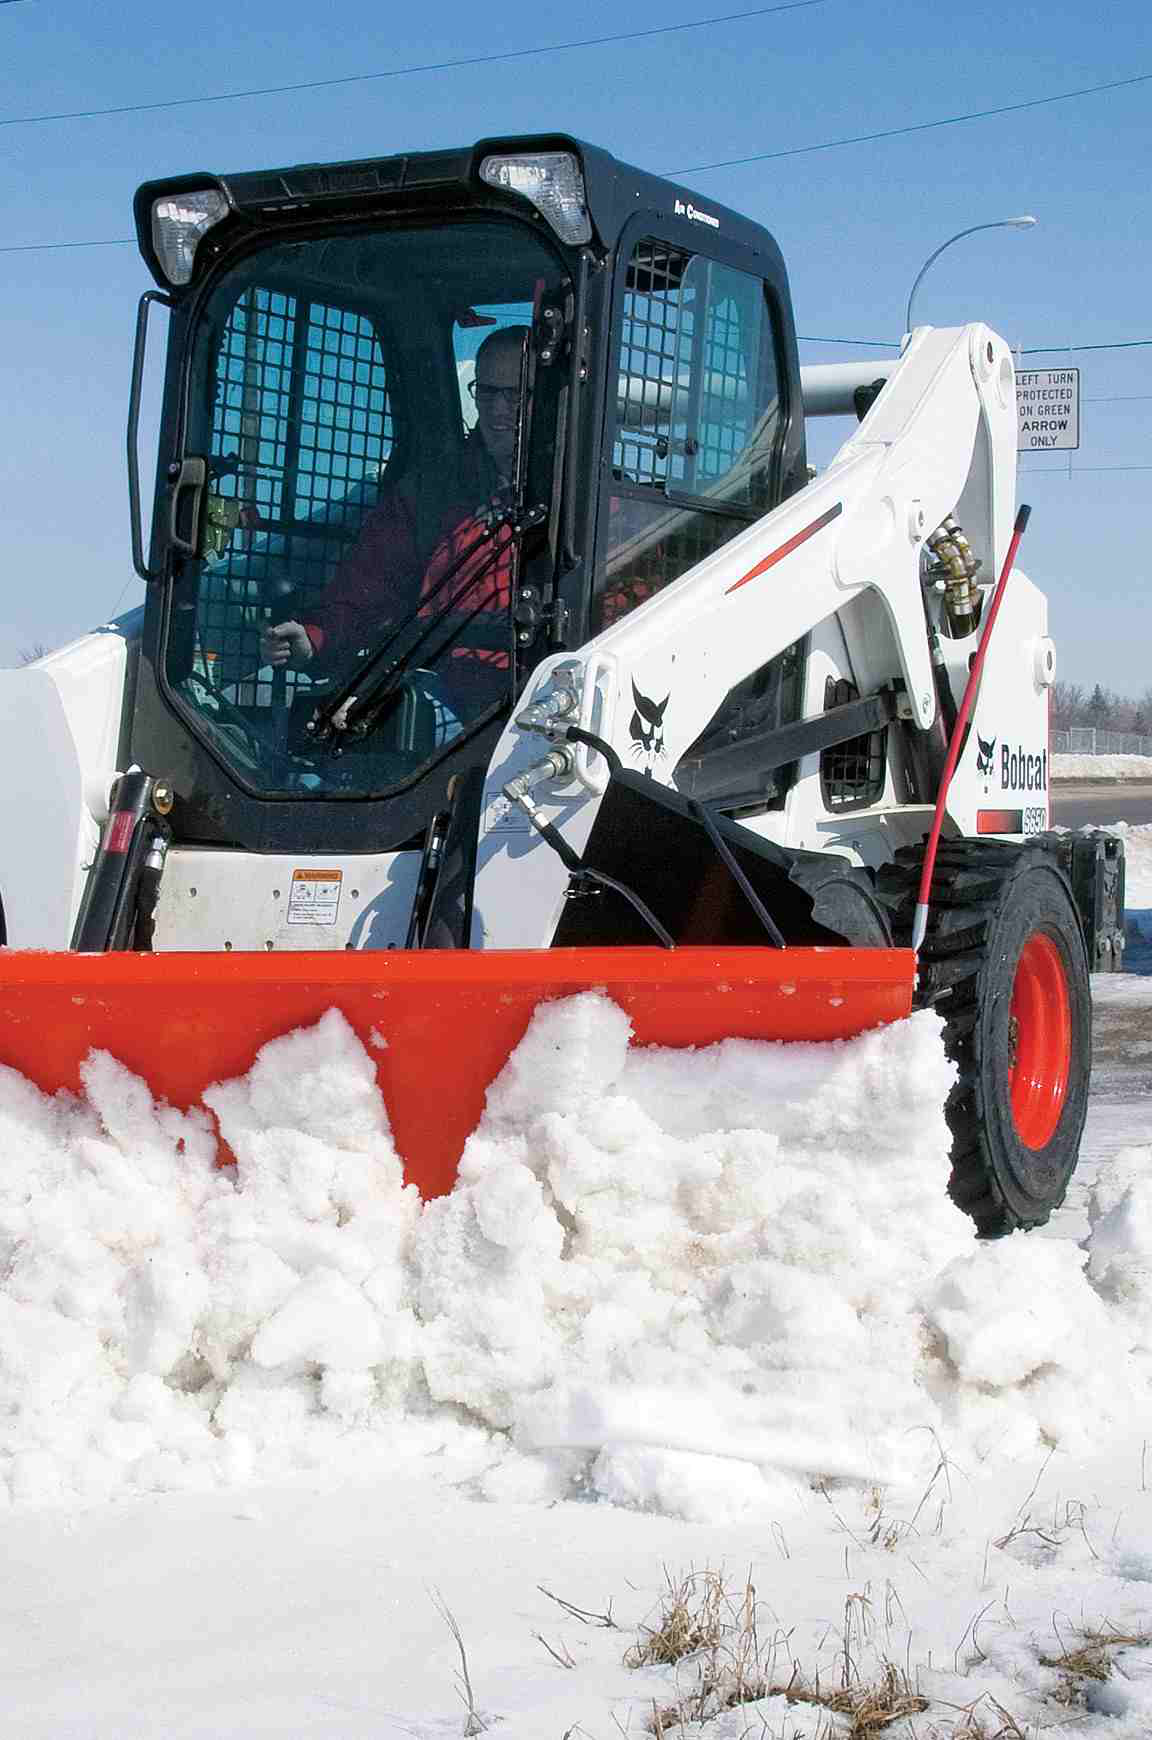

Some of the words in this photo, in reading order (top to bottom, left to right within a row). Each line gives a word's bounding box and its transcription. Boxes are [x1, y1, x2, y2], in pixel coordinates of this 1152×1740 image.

[1015, 374, 1039, 386] LEFT
[1048, 373, 1074, 385] TURN
[1016, 388, 1073, 401] PROTECTED
[1019, 406, 1033, 416] ON
[1037, 404, 1071, 416] GREEN
[1021, 420, 1068, 432] ARROW
[1030, 436, 1058, 447] ONLY
[1001, 744, 1047, 791] Bobcat
